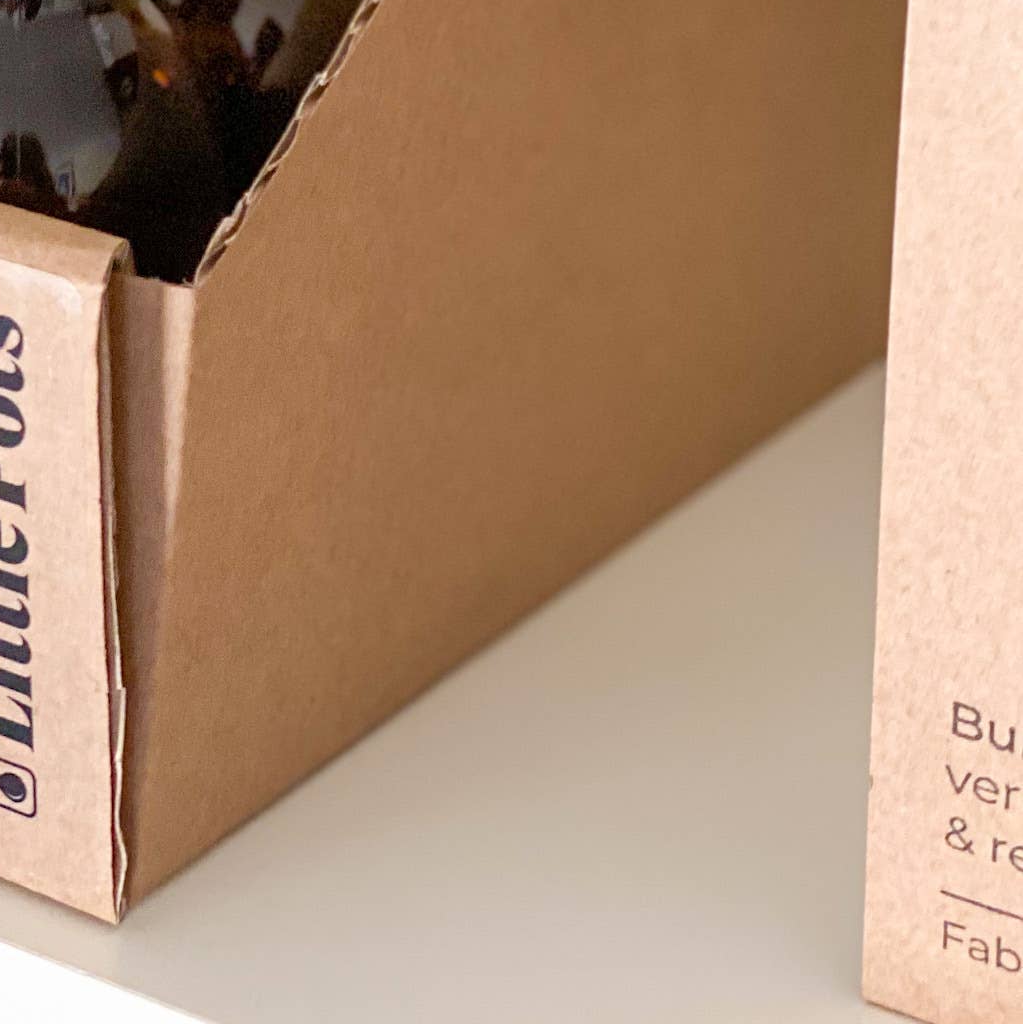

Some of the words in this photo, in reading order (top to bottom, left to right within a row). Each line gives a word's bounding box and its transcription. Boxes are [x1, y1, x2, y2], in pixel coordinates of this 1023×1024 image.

[952, 701, 1023, 760] Bu
[945, 764, 1021, 810] ver
[945, 816, 975, 855] &
[942, 920, 1022, 973] Fab
